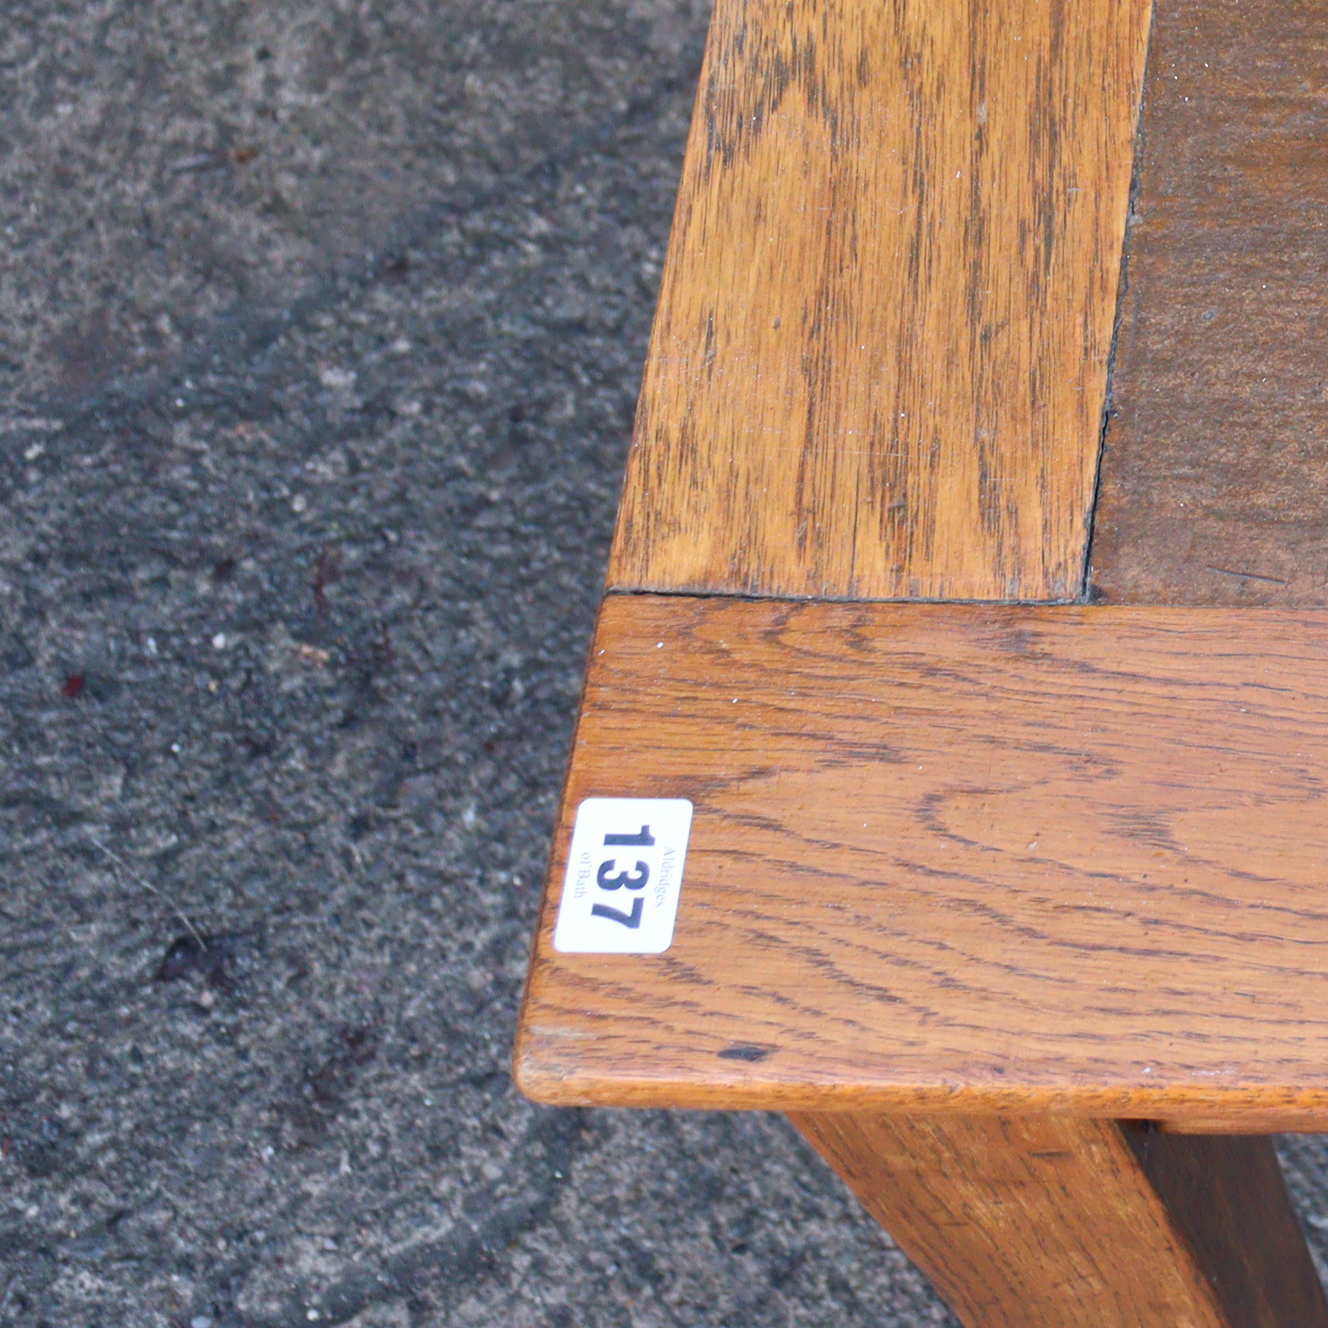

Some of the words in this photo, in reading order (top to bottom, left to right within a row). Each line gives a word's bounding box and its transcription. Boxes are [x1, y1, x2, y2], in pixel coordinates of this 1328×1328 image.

[579, 851, 592, 868] of
[591, 824, 656, 929] 137
[654, 845, 676, 908] Aldridges
[573, 869, 591, 899] Bath
